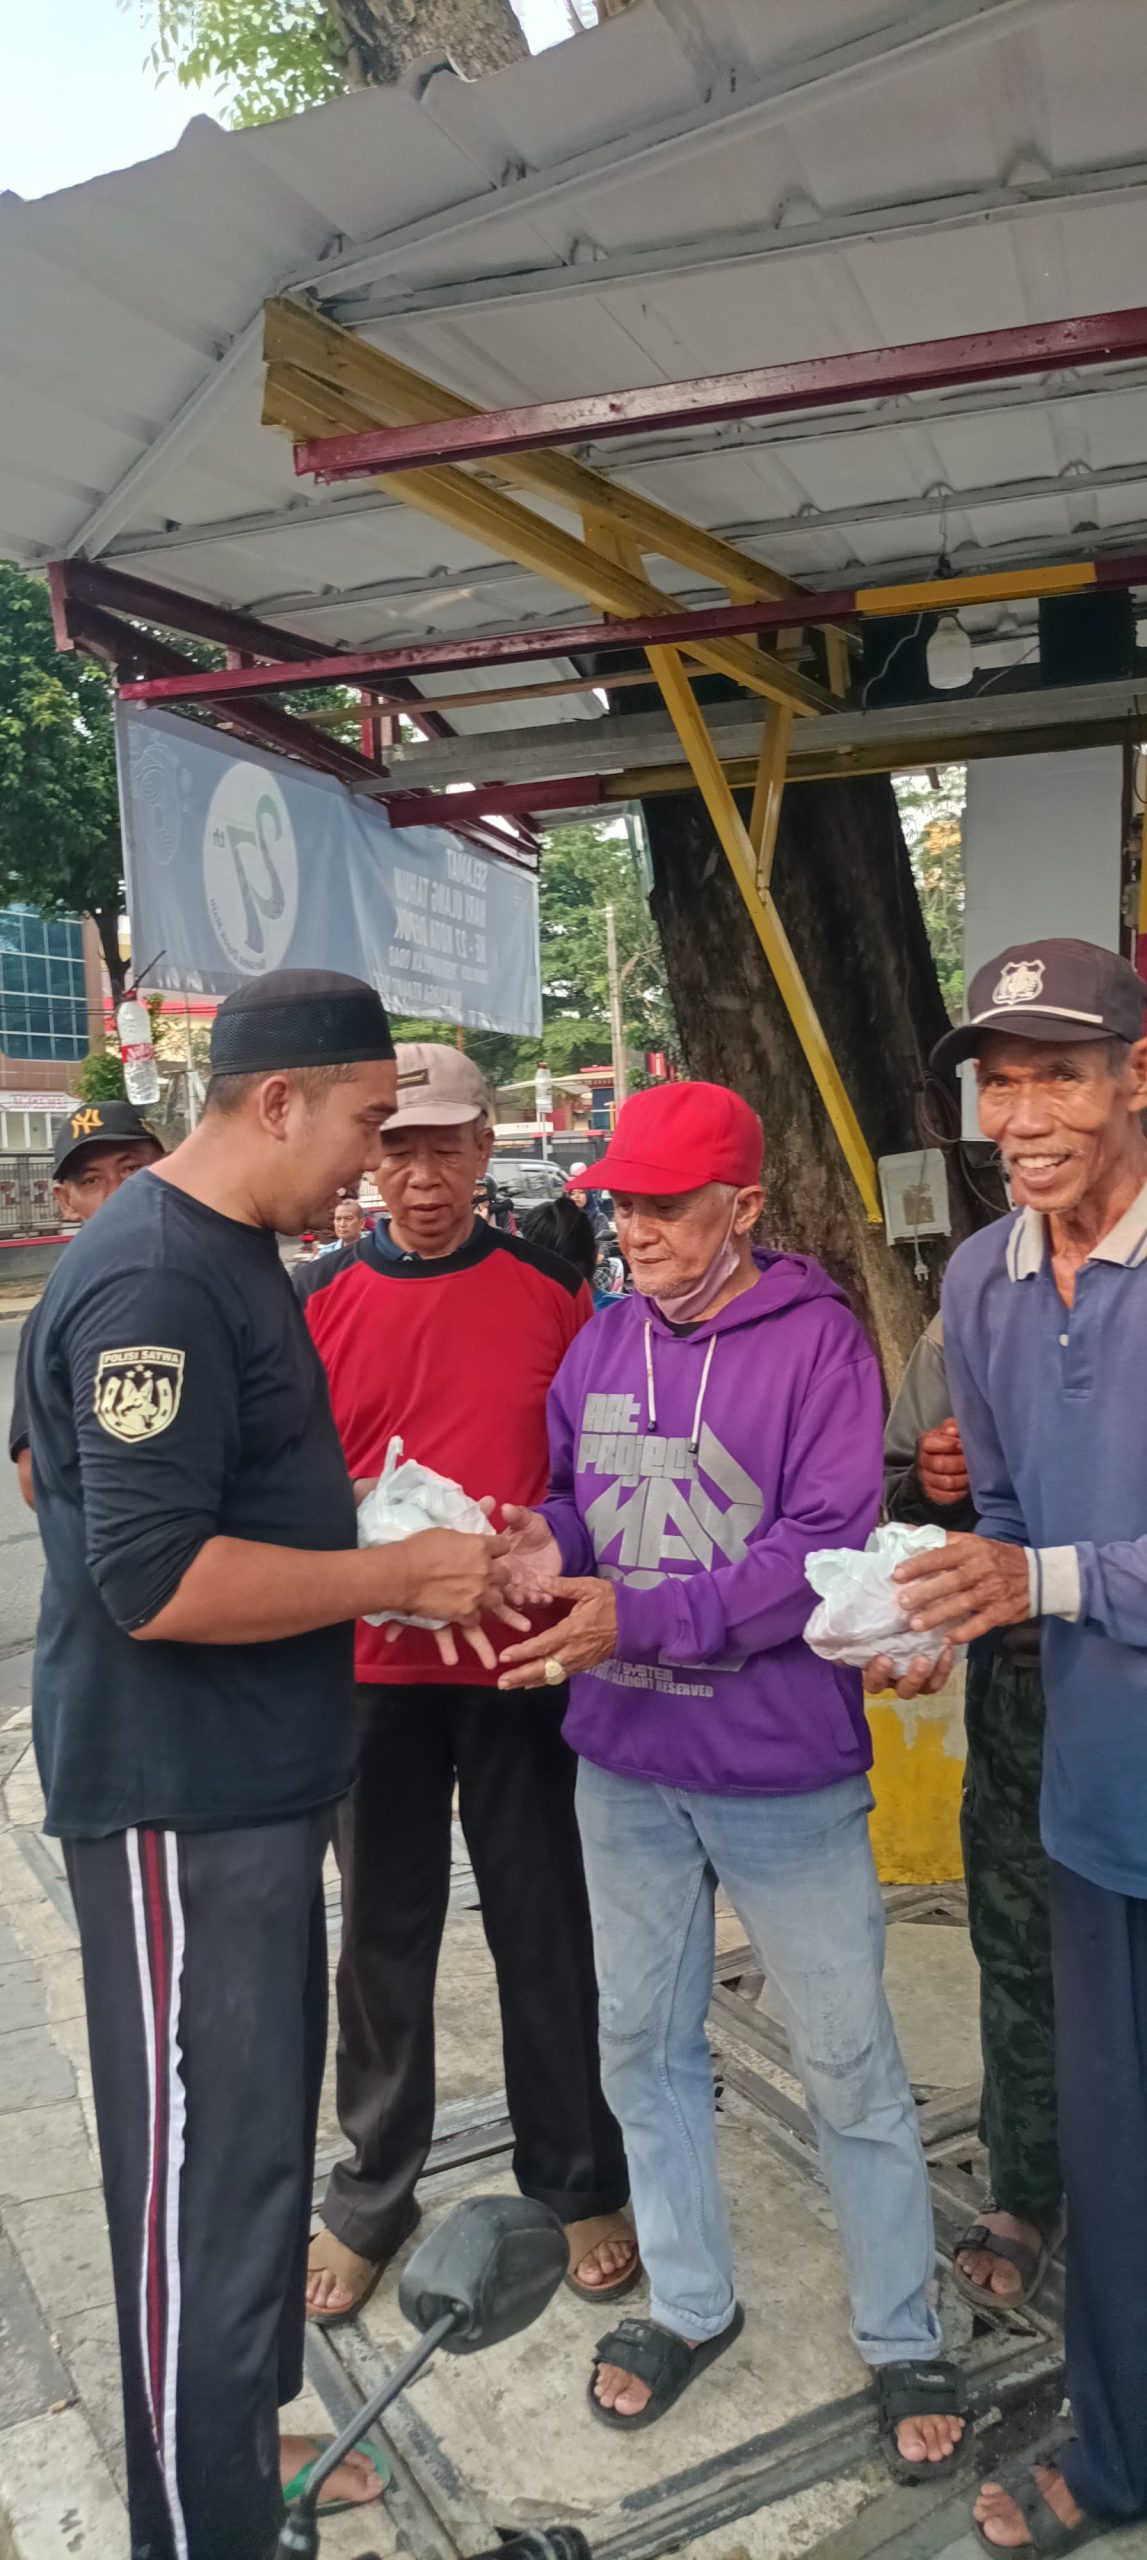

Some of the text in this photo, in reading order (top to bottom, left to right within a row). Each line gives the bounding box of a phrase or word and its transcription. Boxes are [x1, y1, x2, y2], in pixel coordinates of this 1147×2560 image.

[104, 1350, 179, 1364] POLISI SATWA
[656, 1681, 714, 1698] RESERVED
